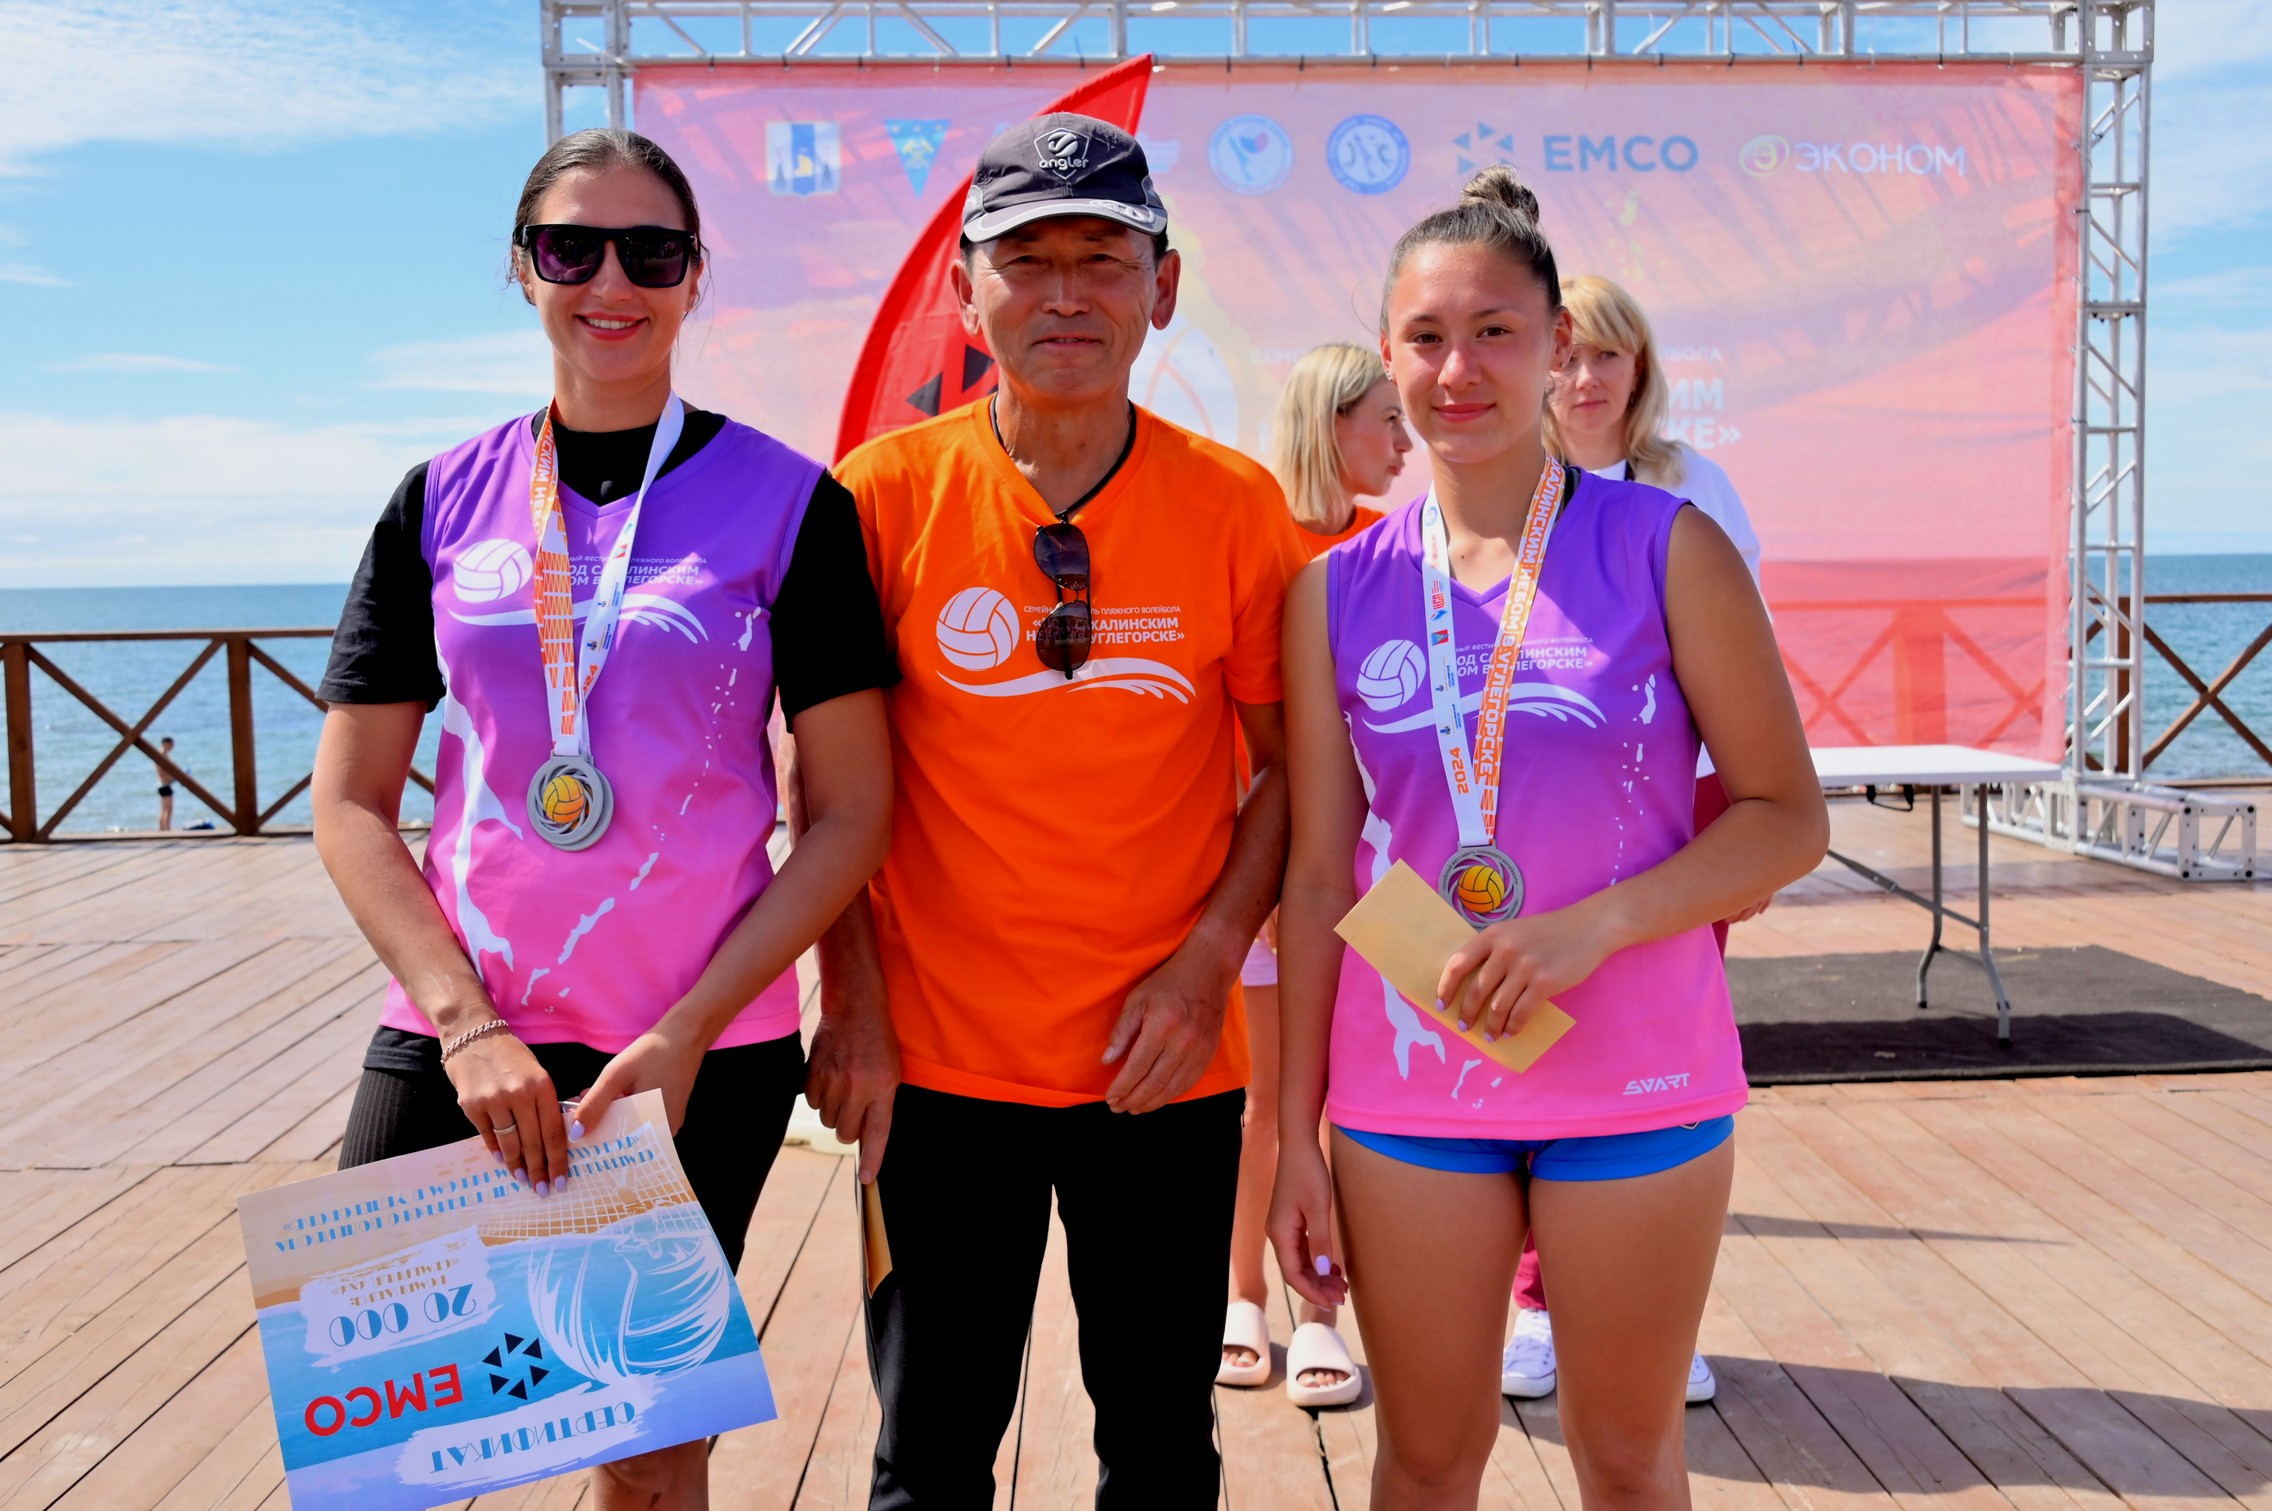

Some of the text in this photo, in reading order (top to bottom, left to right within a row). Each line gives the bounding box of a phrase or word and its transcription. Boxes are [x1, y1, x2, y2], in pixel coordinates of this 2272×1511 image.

[1039, 156, 1089, 171] angler
[1543, 135, 1699, 172] EMCO
[1794, 142, 1965, 176] ЭКОНОМ
[1101, 607, 1140, 615] ПЛЯЖНОГО
[1141, 606, 1181, 614] ВОЛЕЙБОЛА
[1480, 459, 1562, 775] ХАЛИНСКИМ НЕБОМ В УГЛЕГОРСКЕ
[1449, 747, 1469, 794] 2024
[329, 1283, 476, 1347] 20 000
[304, 1363, 463, 1437] EMCO
[430, 1402, 635, 1473] СЕРТИФИКАТ
